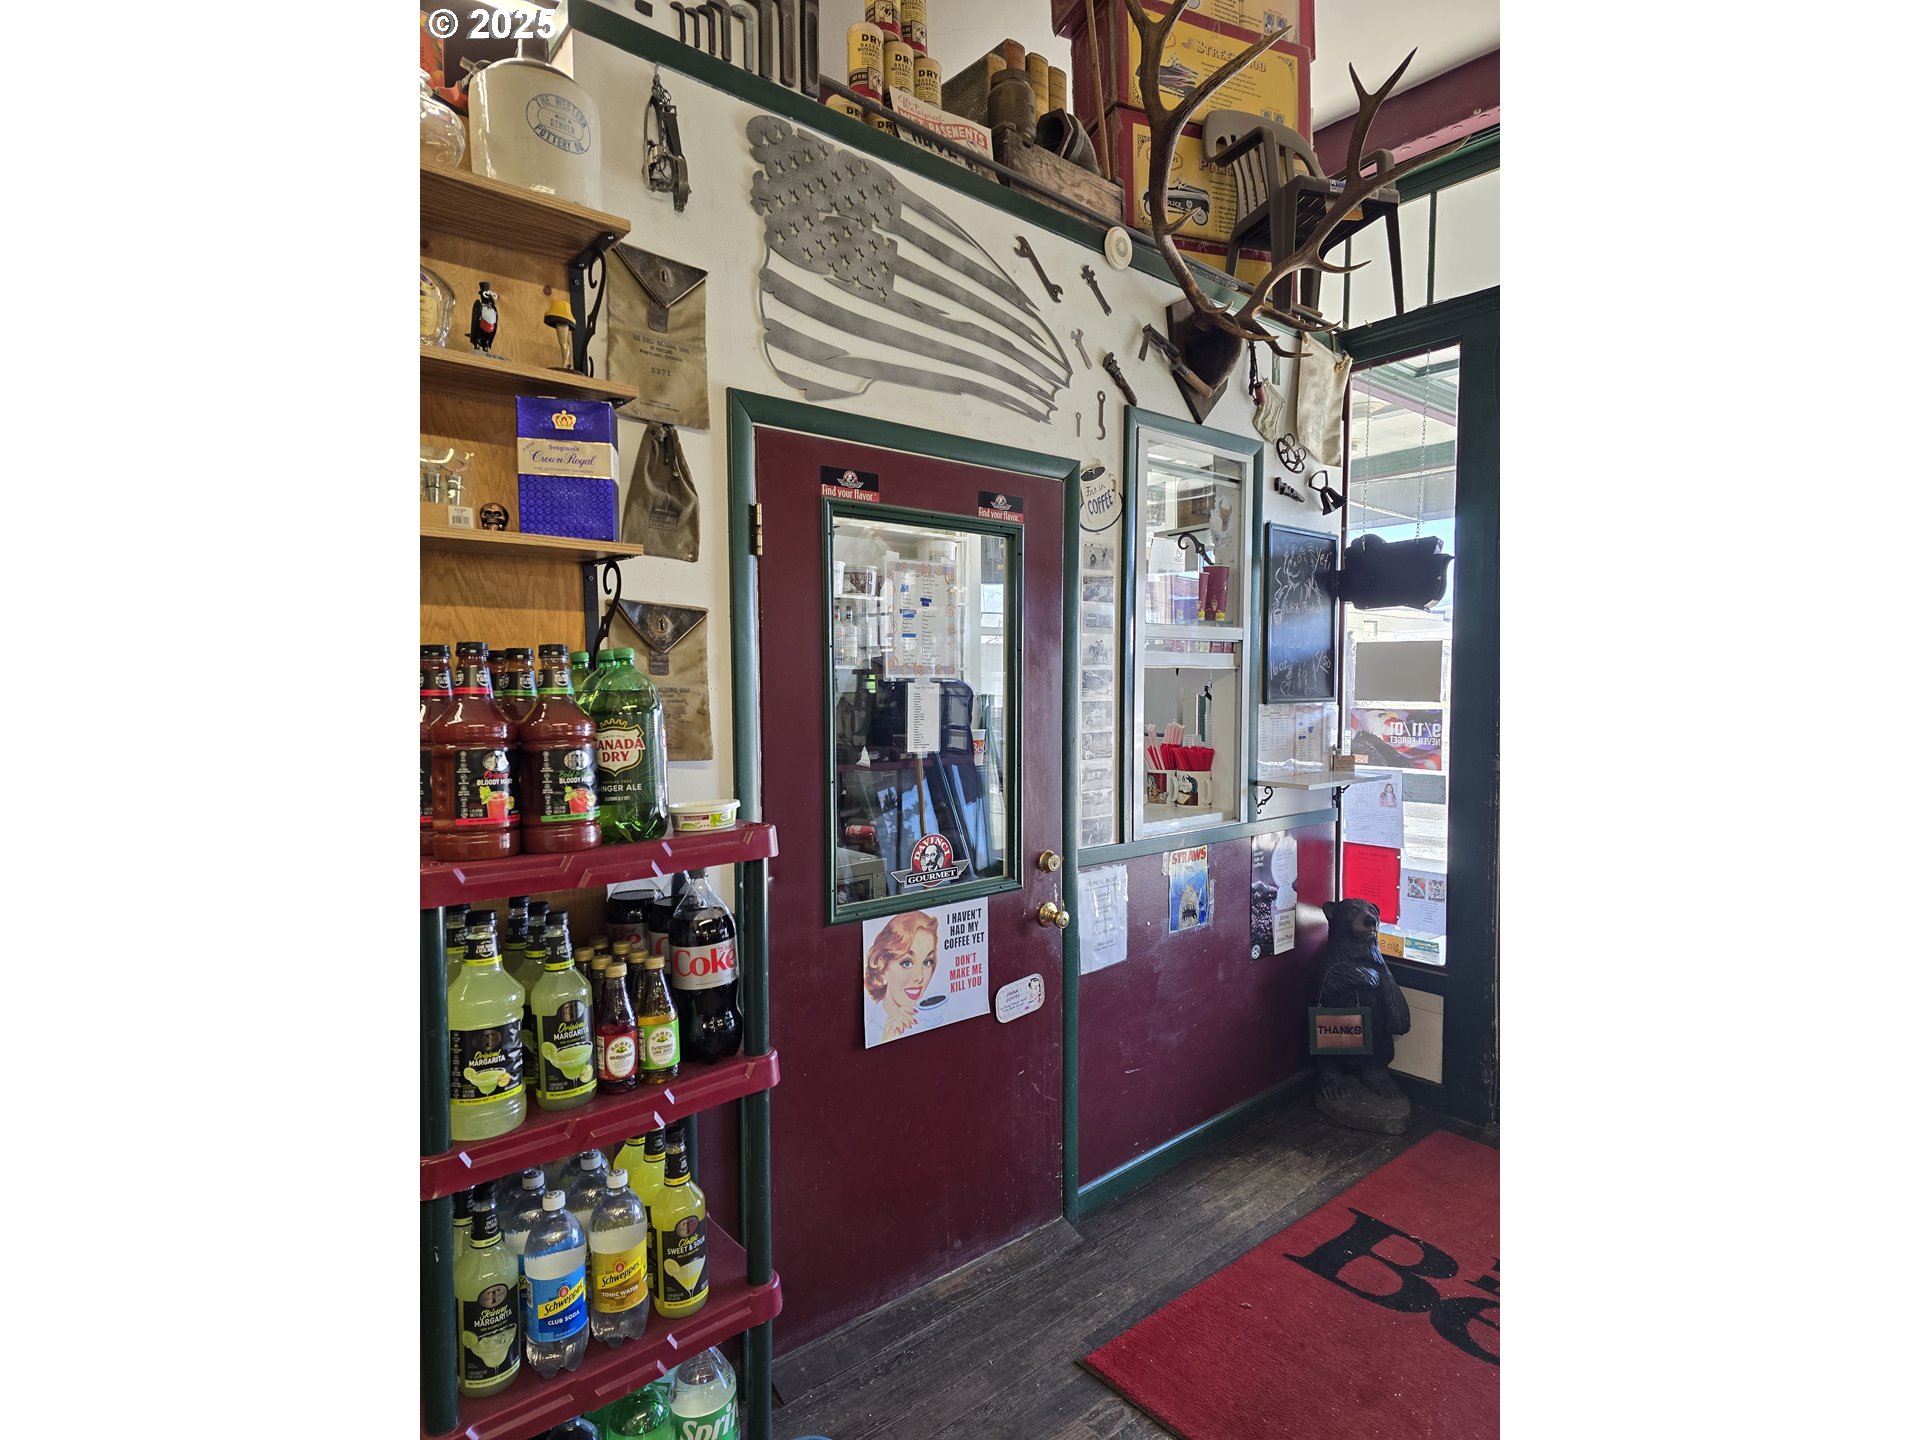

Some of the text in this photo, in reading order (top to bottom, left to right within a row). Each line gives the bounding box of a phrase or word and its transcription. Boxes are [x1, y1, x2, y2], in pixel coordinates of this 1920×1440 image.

[861, 34, 881, 45] DRY
[918, 70, 938, 79] DRY
[533, 95, 551, 107] THE
[1199, 158, 1234, 177] POLIC
[1166, 200, 1181, 208] OLICE
[650, 366, 671, 377] 3371
[548, 443, 580, 452] Seagram's
[529, 450, 597, 467] Crown Royal
[822, 484, 836, 496] Find
[838, 486, 853, 499] your
[1088, 489, 1113, 515] COFFEE
[978, 507, 990, 517] Find
[991, 510, 1003, 519] your
[597, 737, 645, 751] ANADA
[602, 751, 629, 762] DRY
[600, 783, 642, 792] INGER ALE
[914, 836, 951, 861] DAVINCI
[1171, 847, 1206, 865] STRAWS
[908, 869, 956, 884] GOURMET
[946, 908, 982, 924] I HAVEN'T
[950, 921, 979, 936] HAD MY
[944, 932, 985, 950] COFFEE YET
[673, 948, 737, 977] Coke
[955, 952, 977, 967] DON'T
[950, 963, 983, 980] MAKE ME
[950, 975, 982, 993] KILL YOU
[553, 1027, 589, 1041] MARGARITA
[1317, 1025, 1362, 1035] THANKS
[468, 1056, 506, 1067] MARGARITA
[473, 1049, 501, 1062] Original
[667, 1246, 688, 1255] SWEET
[602, 1261, 640, 1287] Schweppes
[620, 1285, 639, 1296] WATER
[544, 1281, 583, 1316] Schweppes
[474, 1309, 513, 1328] MARGARITA
[547, 1310, 581, 1327] CLUB SODA
